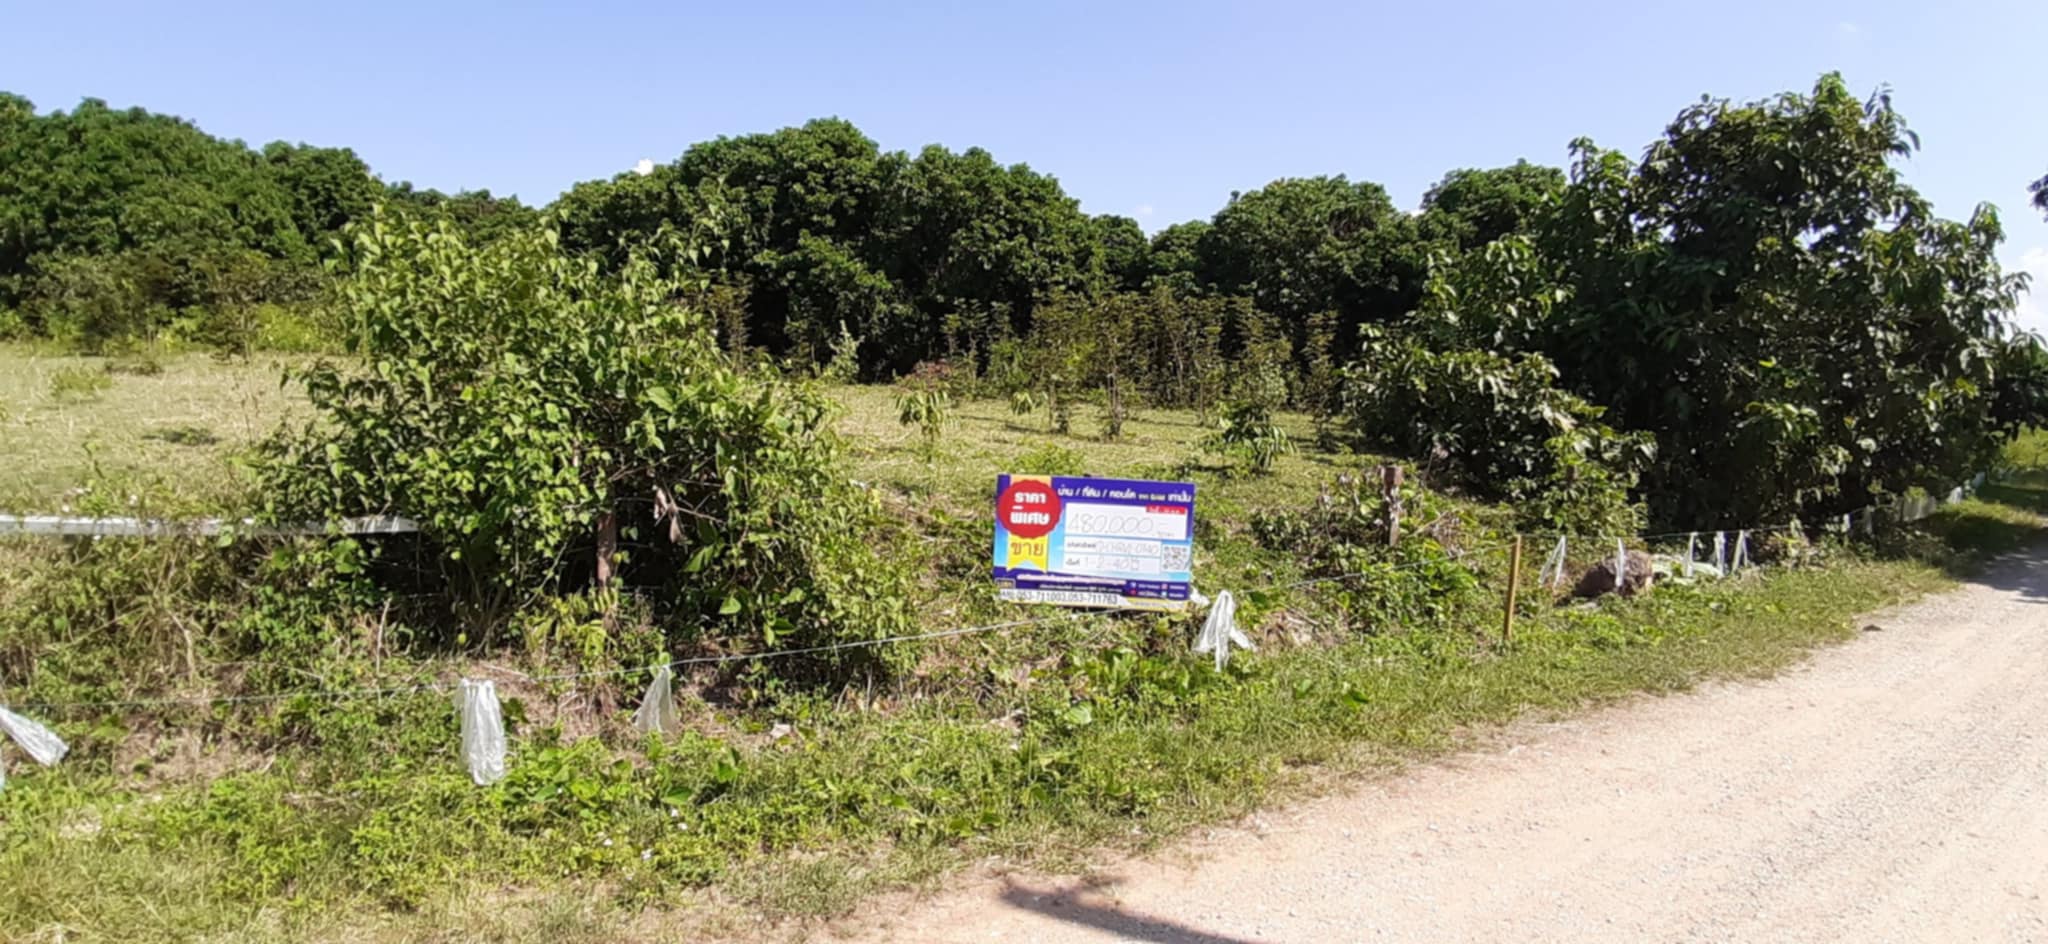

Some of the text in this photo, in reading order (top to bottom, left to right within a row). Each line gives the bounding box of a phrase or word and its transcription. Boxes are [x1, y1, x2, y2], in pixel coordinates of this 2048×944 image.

[1014, 491, 1047, 504] ราคา
[1010, 505, 1050, 525] พิเศษ
[1010, 541, 1044, 556] ขาย
